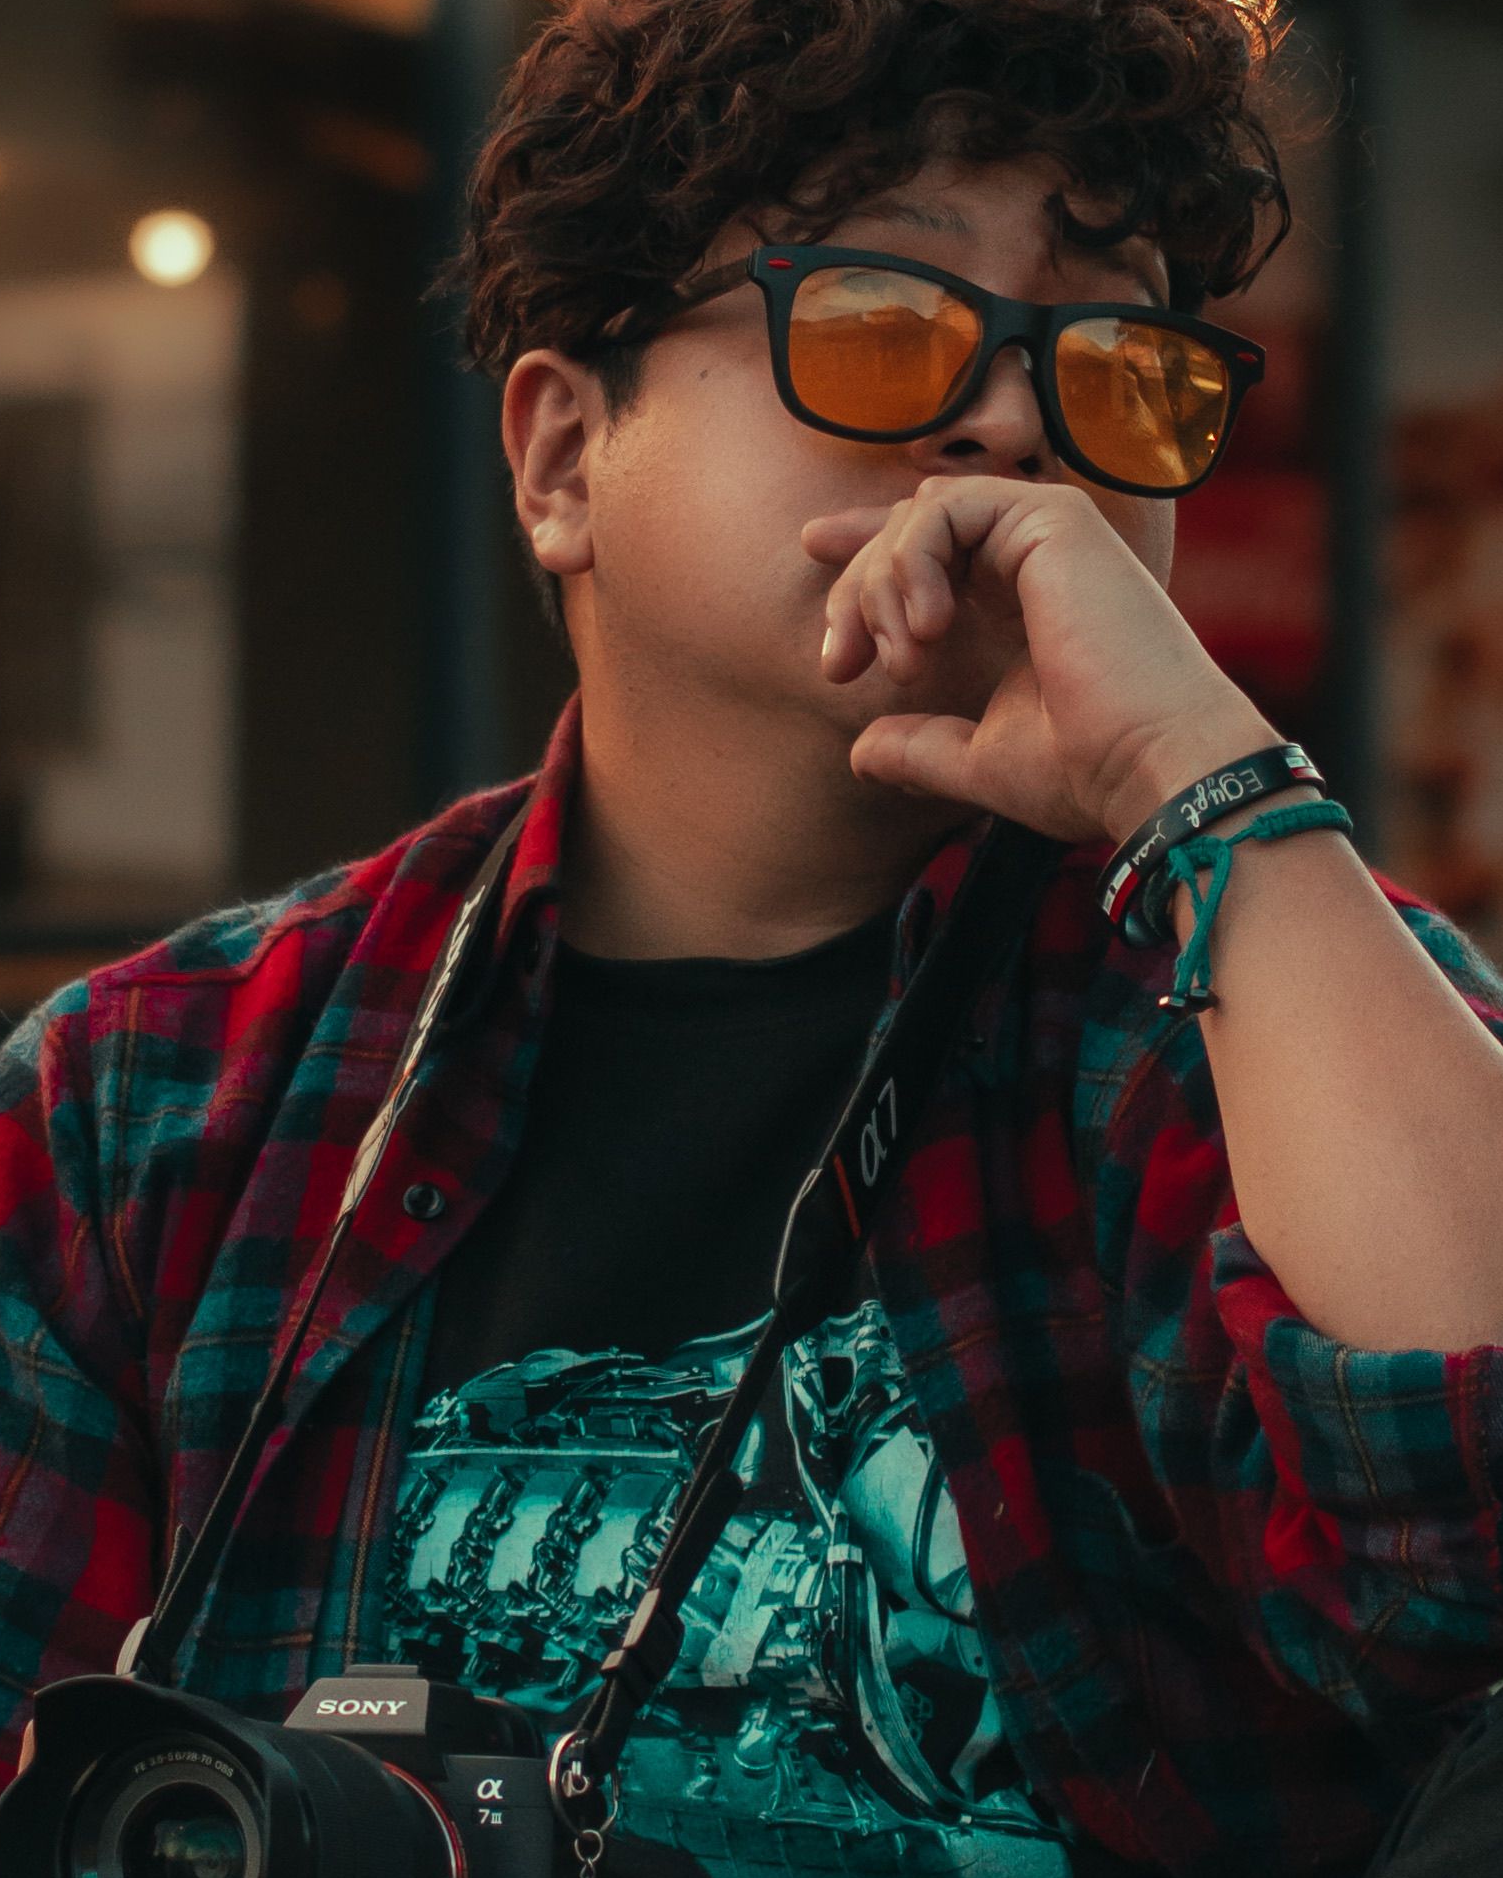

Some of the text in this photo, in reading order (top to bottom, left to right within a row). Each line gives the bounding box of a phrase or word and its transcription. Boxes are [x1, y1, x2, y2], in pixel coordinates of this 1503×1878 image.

[1180, 766, 1264, 828] Egypt
[316, 1699, 408, 1715] SONY
[214, 1760, 235, 1777] OSS
